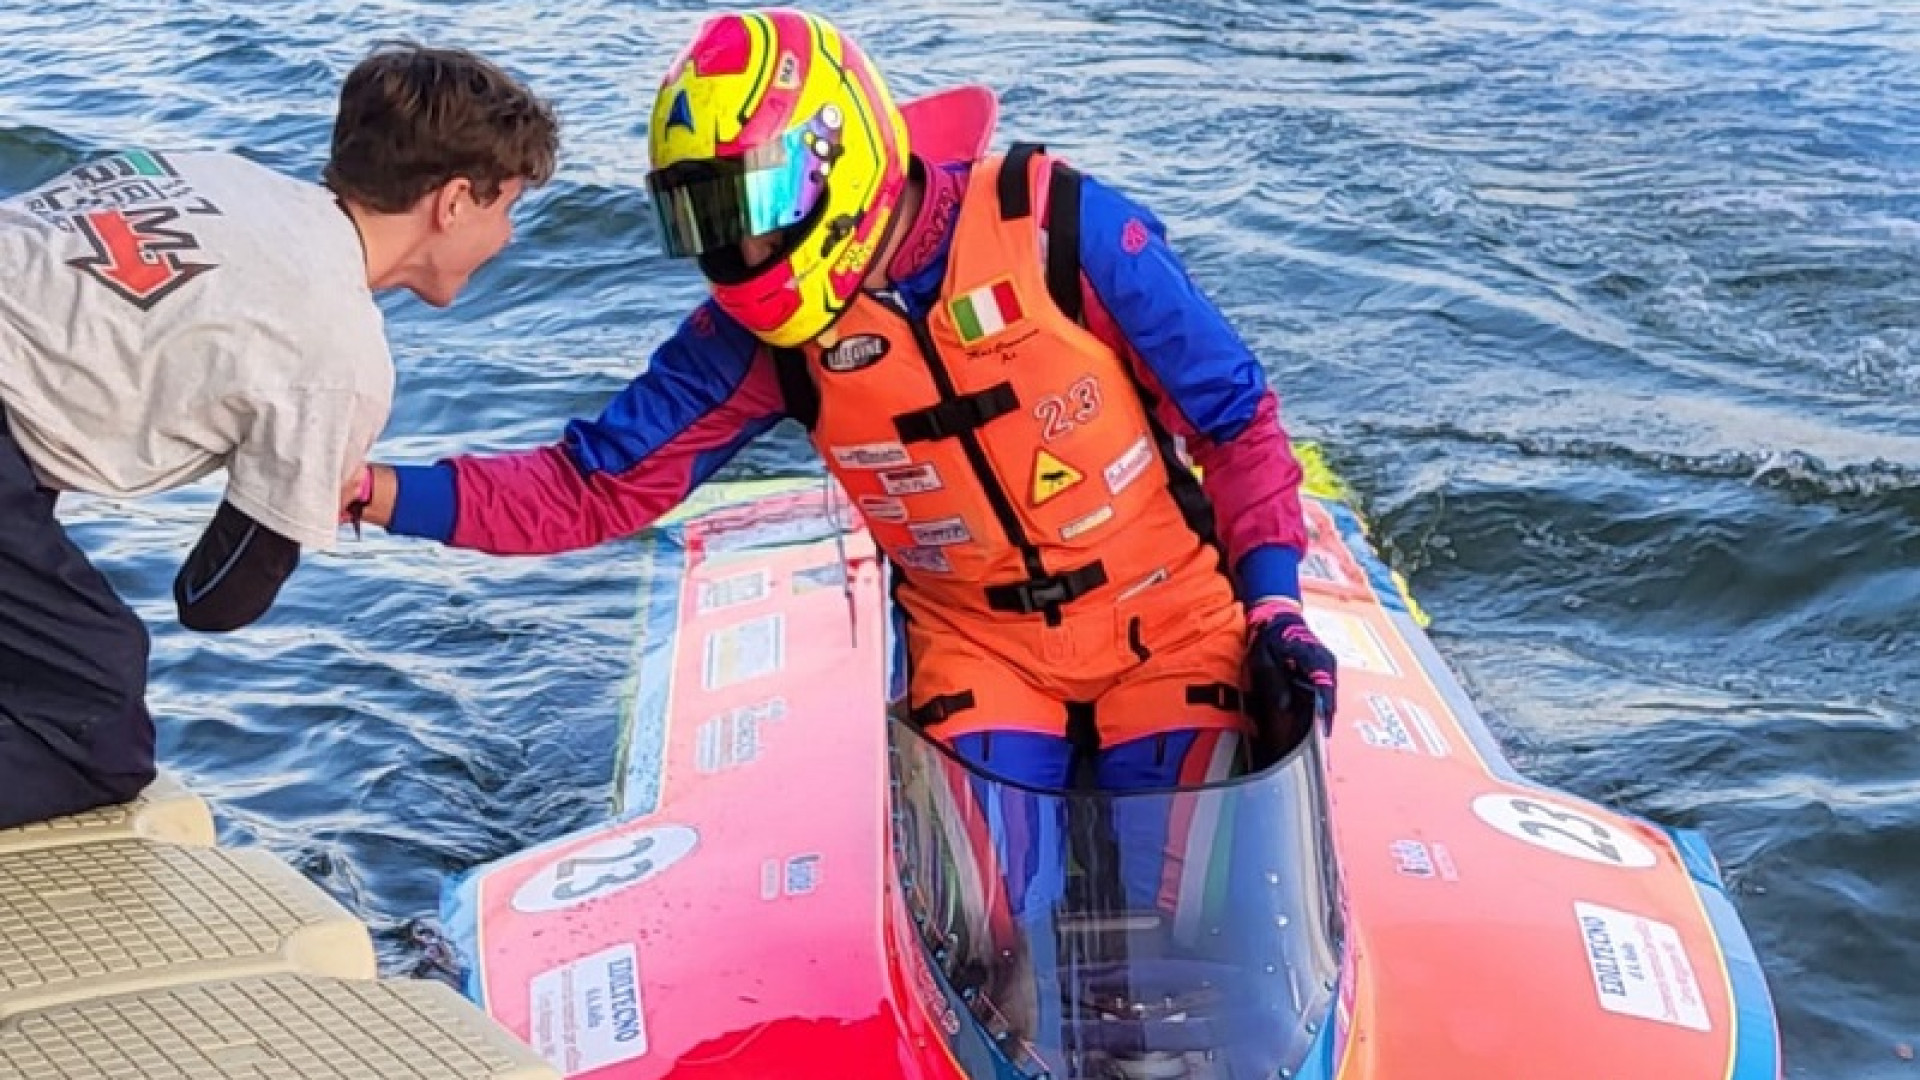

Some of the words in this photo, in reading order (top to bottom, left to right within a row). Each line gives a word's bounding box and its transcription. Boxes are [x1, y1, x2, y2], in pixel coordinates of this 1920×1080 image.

[1033, 374, 1101, 443] 23
[1508, 798, 1623, 863] 23
[552, 836, 654, 901] 23
